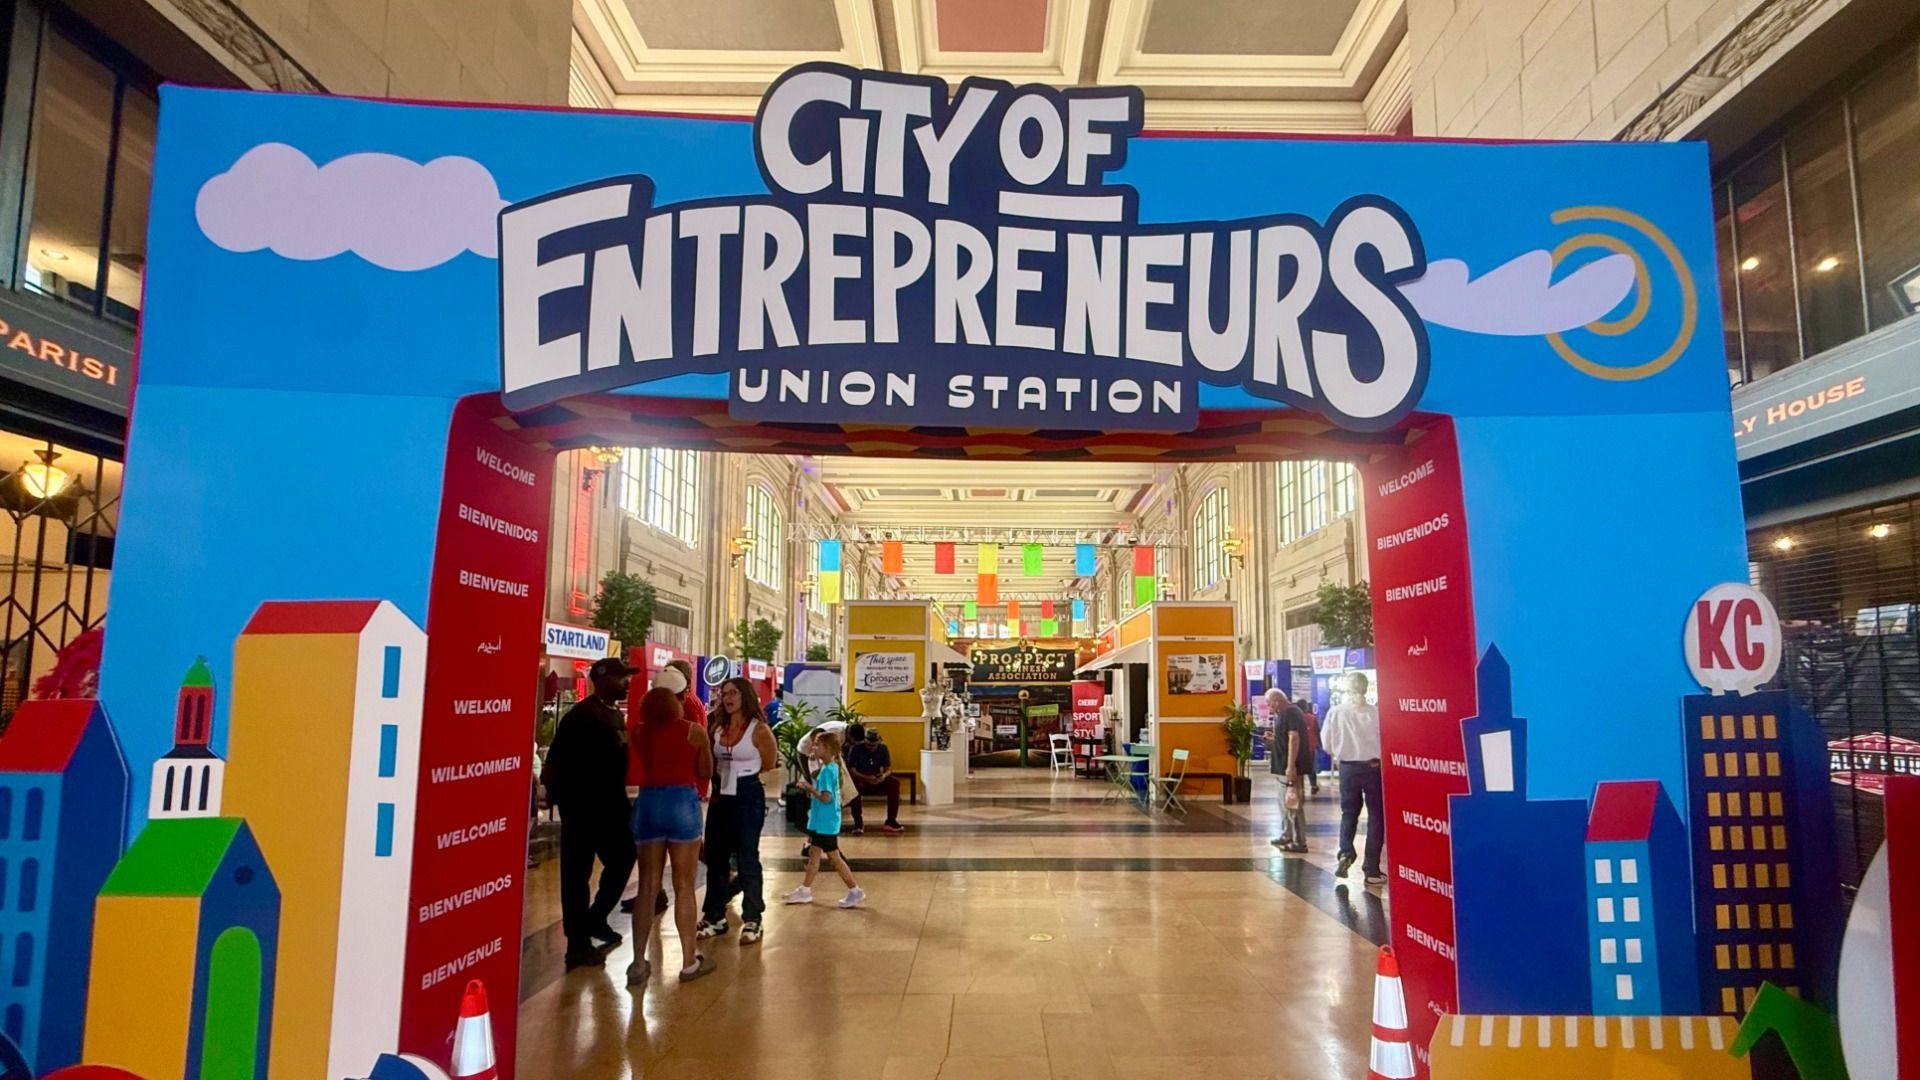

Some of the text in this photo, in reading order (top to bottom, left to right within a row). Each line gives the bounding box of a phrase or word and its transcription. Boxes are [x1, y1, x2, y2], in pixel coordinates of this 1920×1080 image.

[760, 71, 1129, 205] CITY OF
[502, 184, 1418, 418] ENTREPRENEURS
[738, 368, 1182, 414] UNION STATION
[1766, 376, 1866, 426] HOUSE
[475, 447, 536, 487] WELCOME
[1378, 459, 1435, 497] WELCOME
[458, 503, 539, 543] BIENVENIDOS
[1377, 513, 1449, 550] BIENVENIDOS
[459, 570, 529, 597] BIENVENUE
[1385, 576, 1447, 602] BIENVENUE
[547, 628, 606, 652] STARTLAND
[1697, 598, 1765, 672] KC
[866, 654, 886, 666] This
[979, 653, 1068, 665] PROSPECT
[869, 674, 909, 683] prospect
[454, 699, 512, 715] WELKOM
[1399, 698, 1447, 713] WELKOM
[1073, 728, 1096, 739] STYL
[430, 755, 521, 784] WILLKOMMEN
[1391, 752, 1466, 777] WILLKOMMEN
[1829, 752, 1872, 770] ALLY
[437, 817, 507, 850] WELCOME
[1402, 810, 1450, 836] WELCOM
[419, 874, 512, 924] BIENVENIDOS
[1406, 923, 1455, 962] BIENVEN
[421, 937, 503, 991] BIENVENUE
